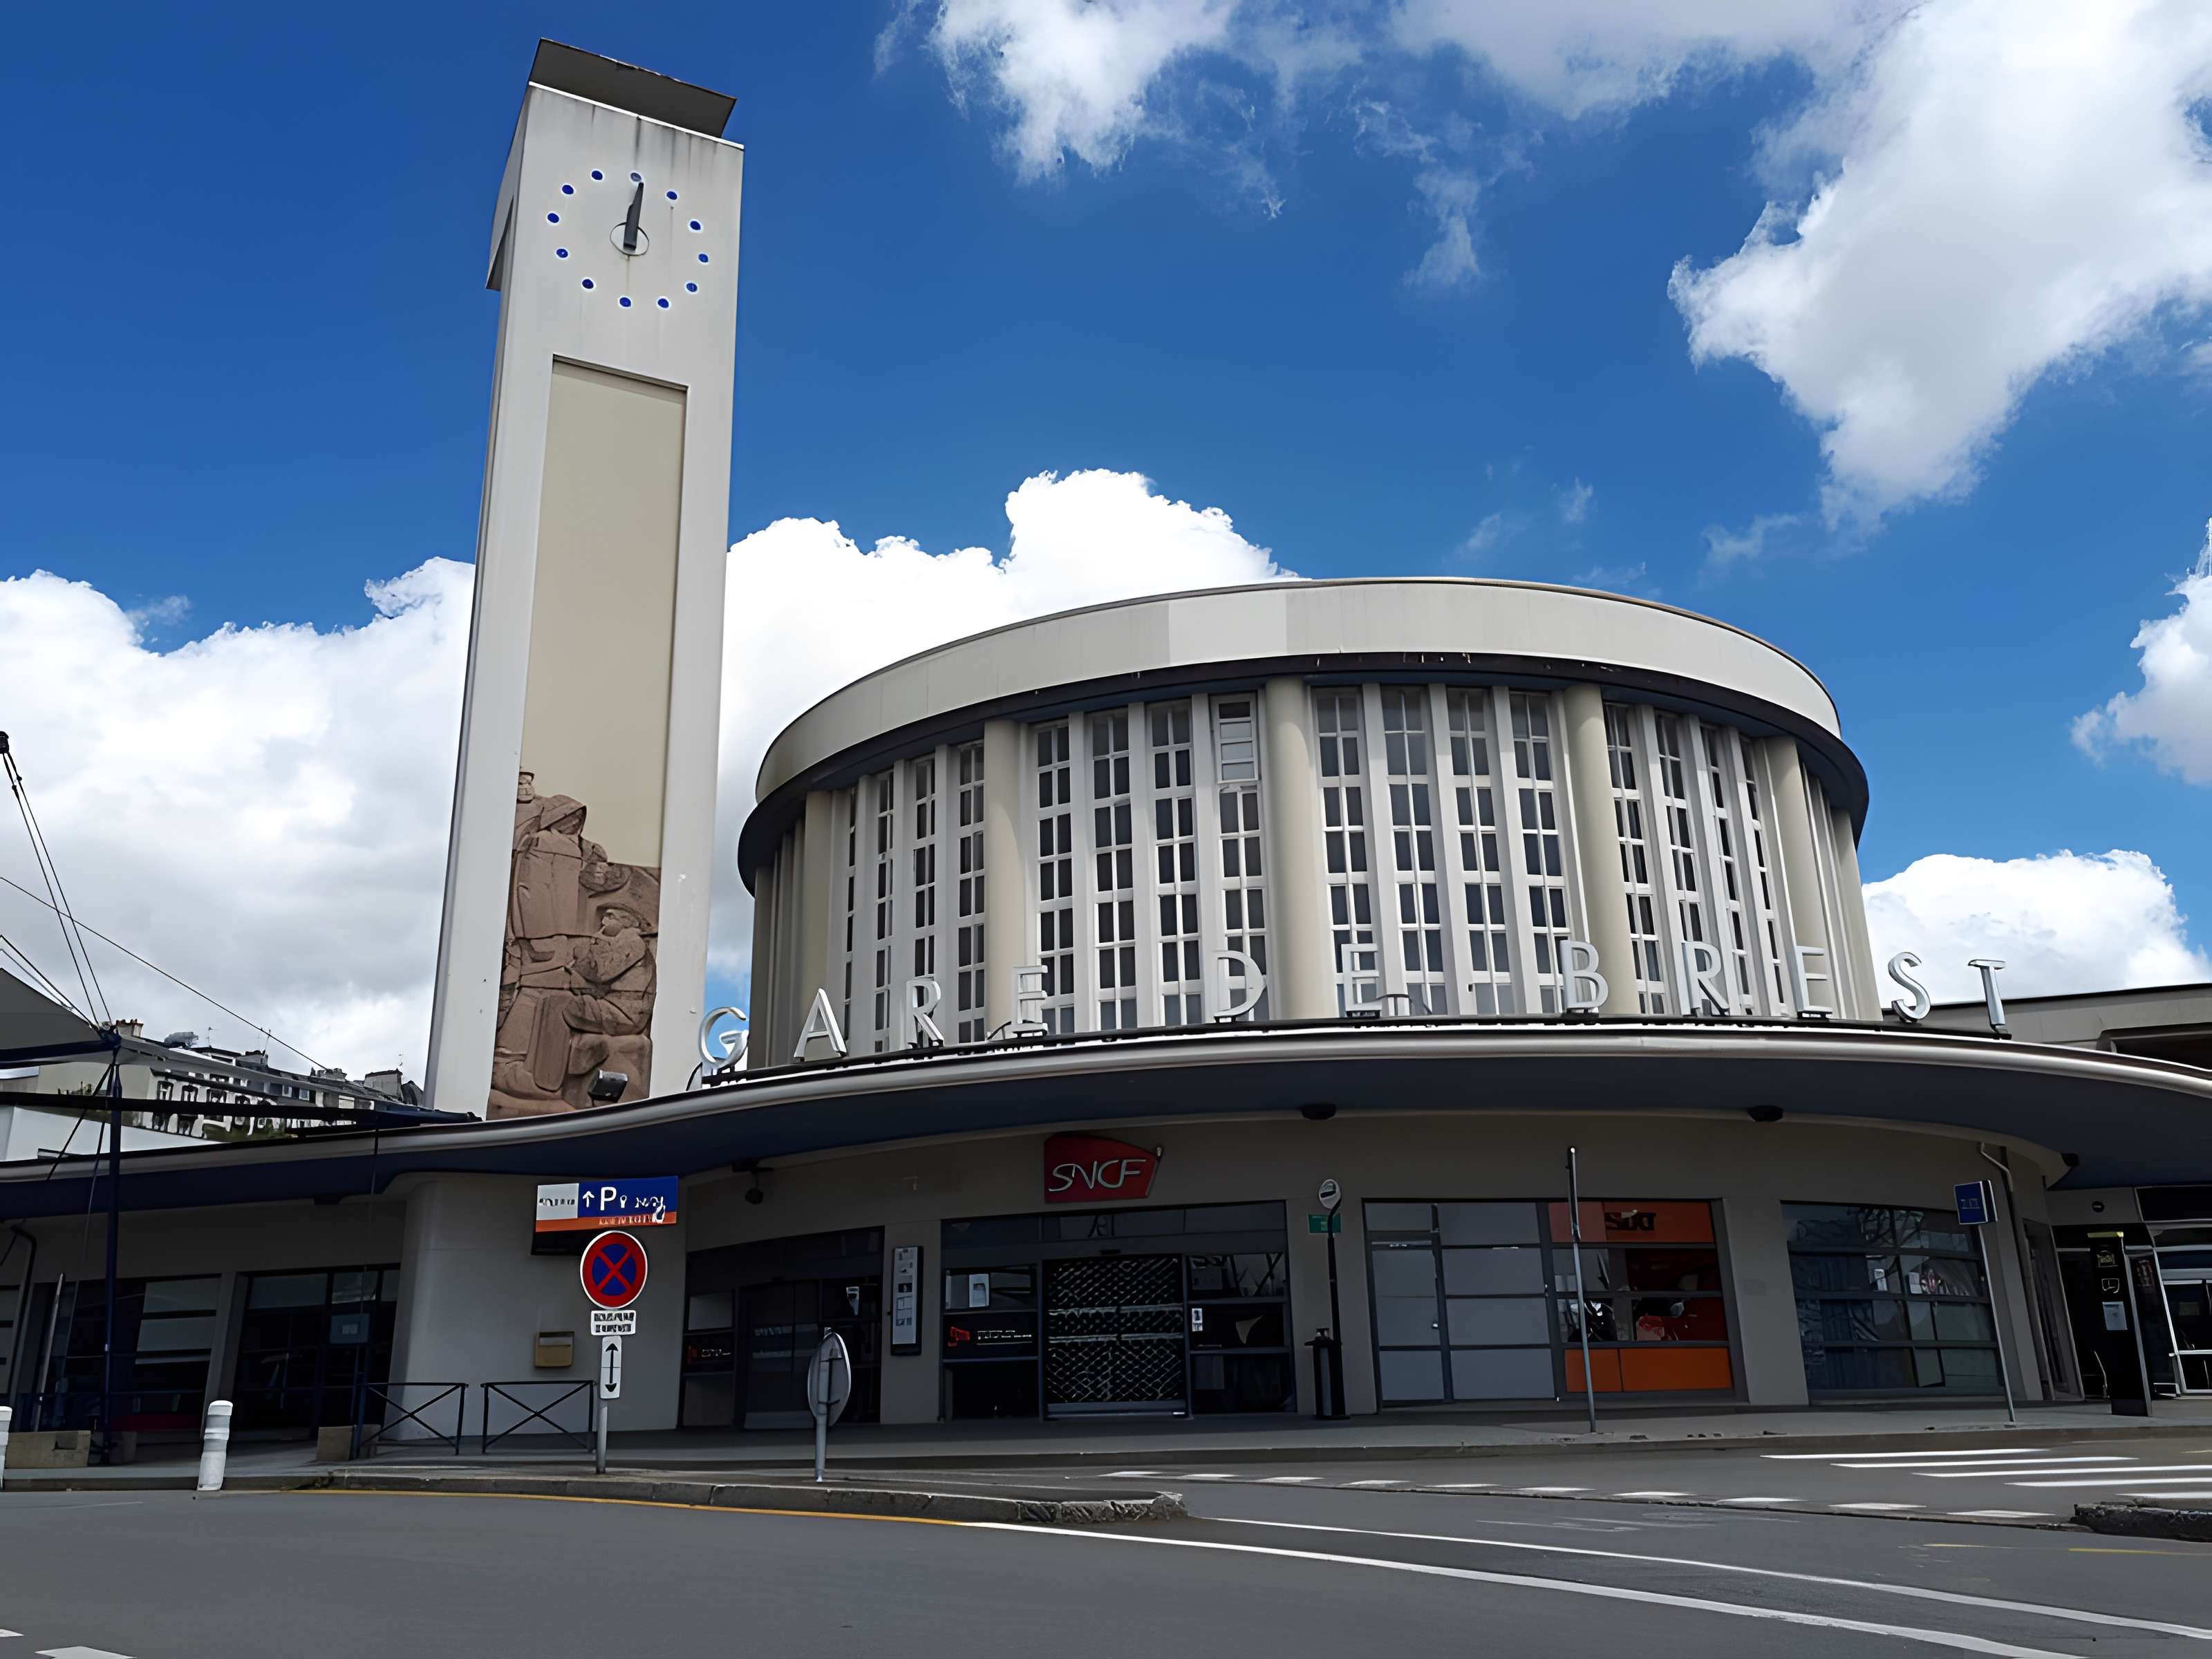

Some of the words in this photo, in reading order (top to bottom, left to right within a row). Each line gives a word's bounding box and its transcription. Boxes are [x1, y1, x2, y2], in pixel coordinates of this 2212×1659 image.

[698, 964, 1048, 1070] GARE
[1213, 943, 1382, 1018] DE
[1559, 939, 2007, 1030] BREST
[1049, 1159, 1146, 1192] SNCF
